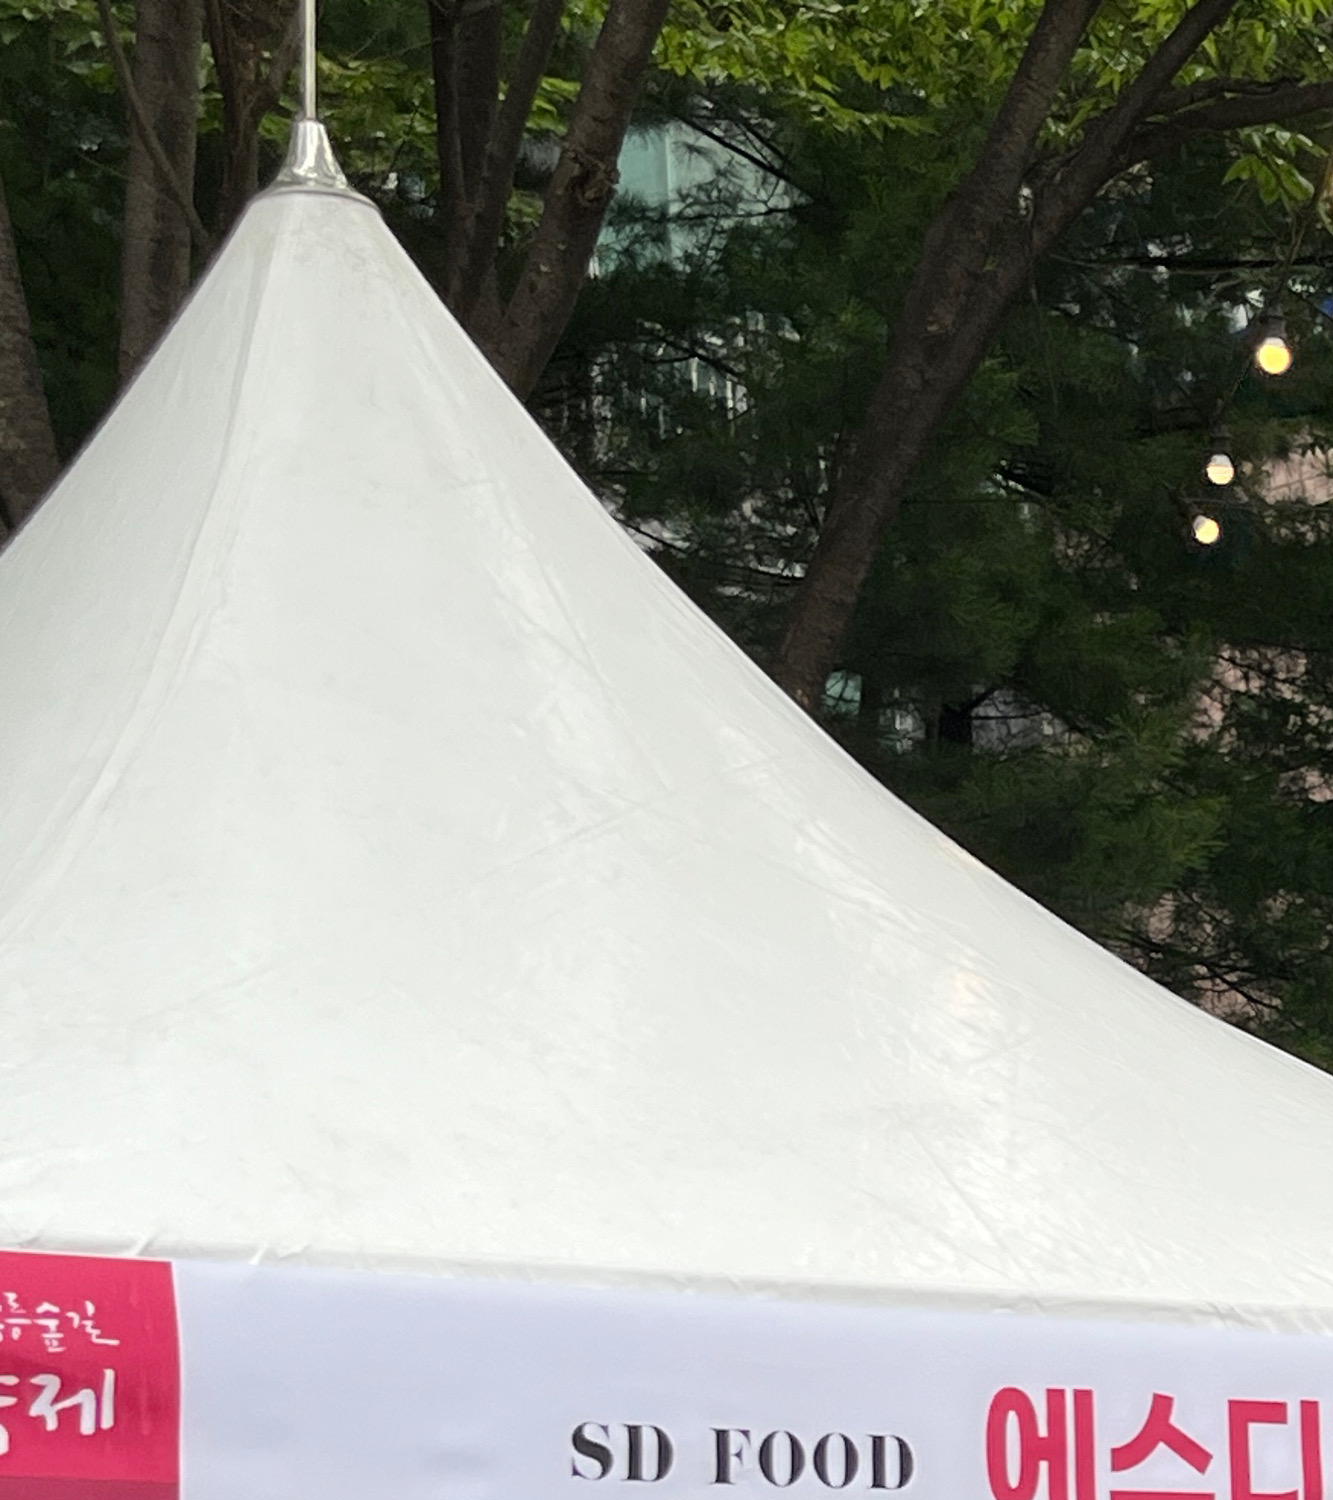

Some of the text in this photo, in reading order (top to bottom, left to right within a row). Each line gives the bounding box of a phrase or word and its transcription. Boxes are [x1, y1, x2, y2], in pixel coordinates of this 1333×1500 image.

[0, 1291, 121, 1352] 릉숲길
[571, 1420, 916, 1491] SD FOOD
